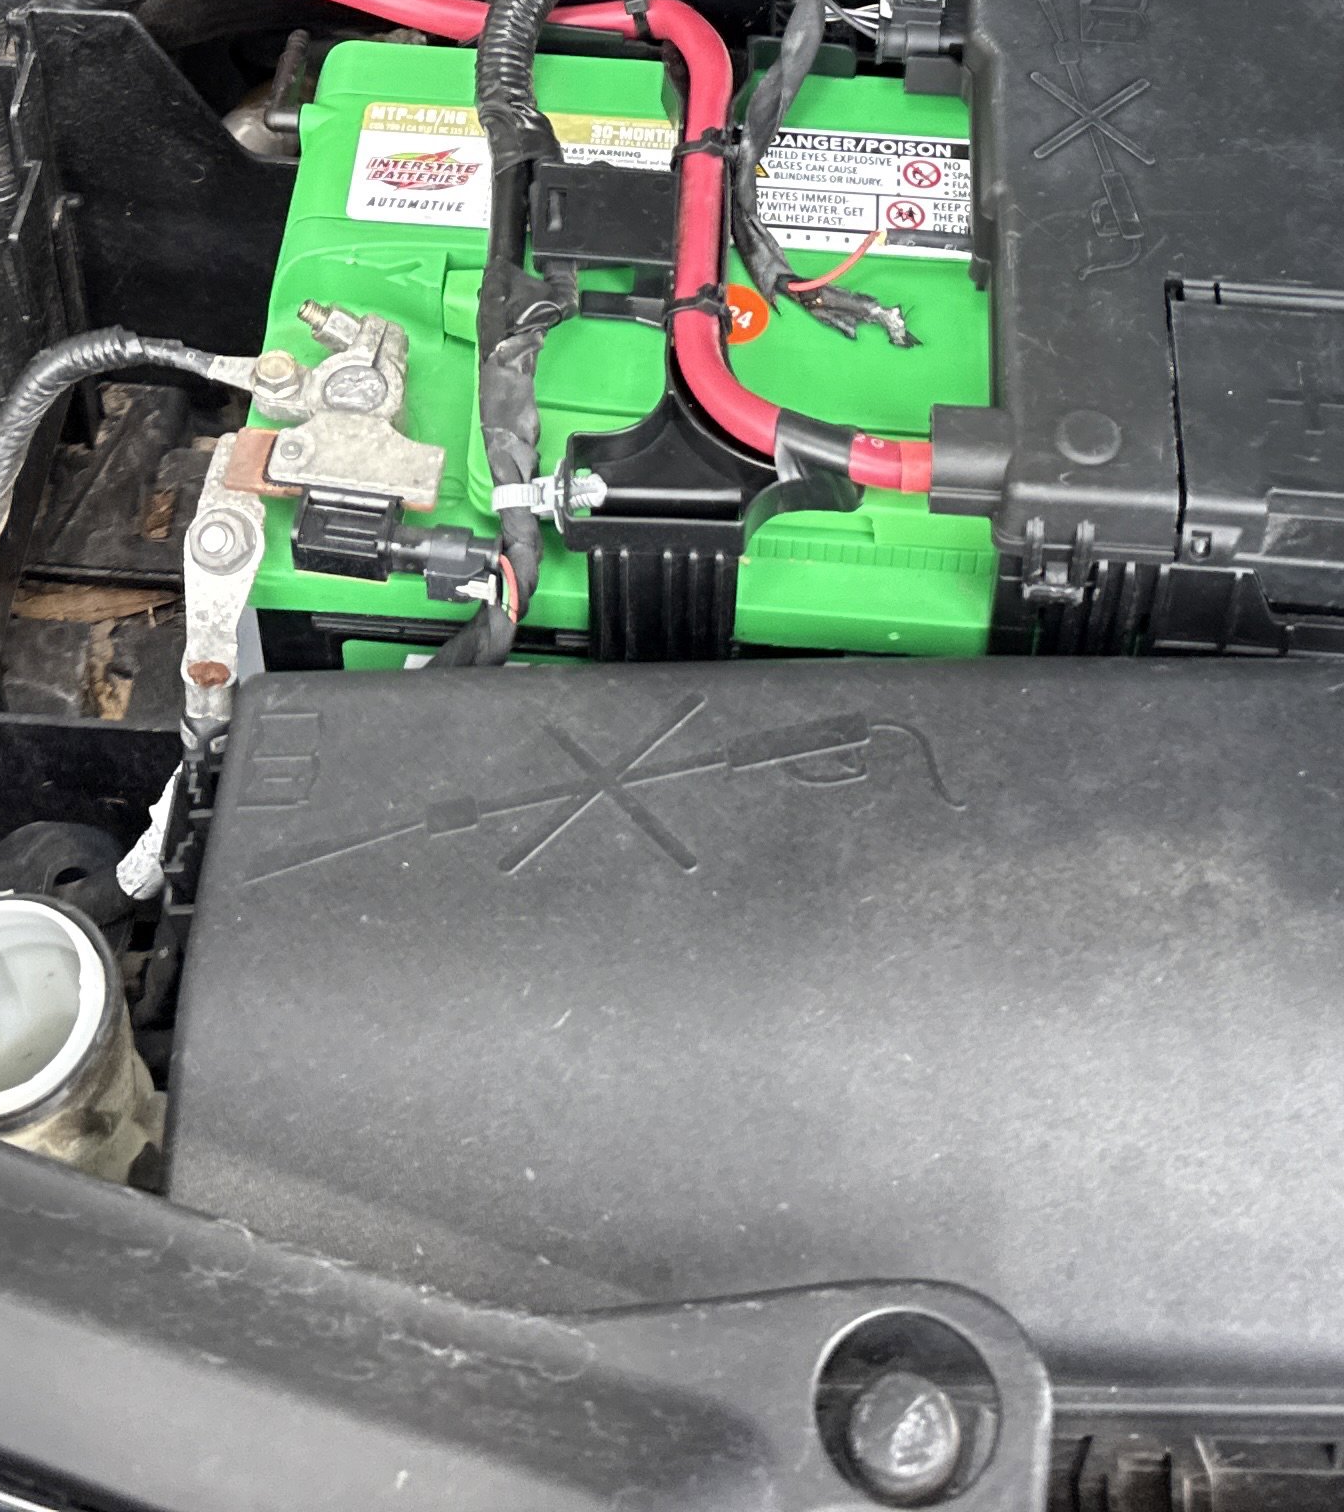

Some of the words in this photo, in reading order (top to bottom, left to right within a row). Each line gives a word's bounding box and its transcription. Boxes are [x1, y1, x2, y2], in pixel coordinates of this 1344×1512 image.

[571, 147, 585, 155] 65
[588, 148, 642, 159] WARNING
[765, 149, 799, 160] HIELD
[833, 154, 893, 166] EXPLOSIVE
[370, 158, 478, 174] INTERSTATE
[767, 160, 803, 170] GASES
[805, 162, 826, 172] CAN
[827, 164, 858, 174] CAUSE
[943, 161, 961, 171] NO
[371, 170, 469, 184] BATTERIES
[774, 171, 828, 182] BLINDNESS
[829, 174, 843, 183] OR
[952, 172, 971, 180] SPA
[952, 180, 969, 189] FLA
[772, 190, 798, 201] EYES
[366, 196, 466, 212] AUTOMOTIVE
[767, 201, 796, 212] WITH
[843, 206, 865, 217] GET
[933, 201, 961, 212] KEEP
[786, 214, 814, 224] HELP
[932, 213, 955, 223] THE
